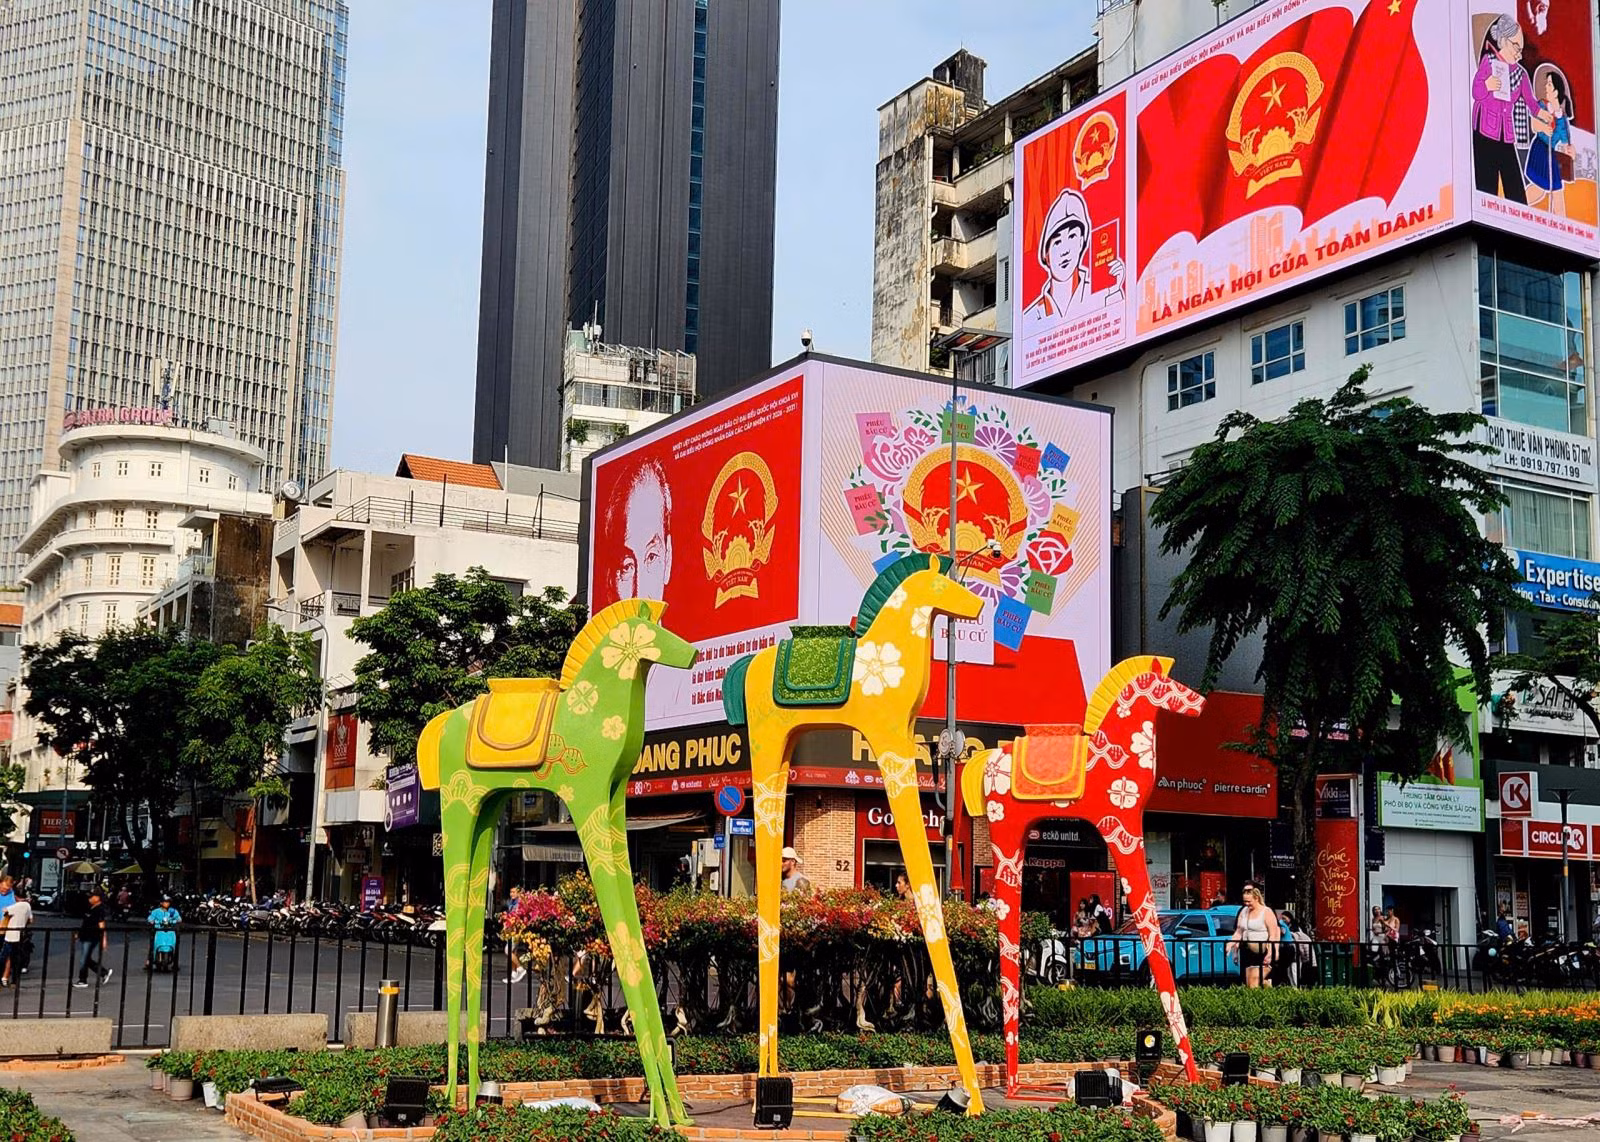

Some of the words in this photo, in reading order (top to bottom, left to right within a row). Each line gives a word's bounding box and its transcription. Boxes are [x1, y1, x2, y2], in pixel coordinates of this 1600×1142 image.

[1152, 303, 1172, 323] LÀ
[1178, 283, 1225, 314] NGÀY
[1231, 270, 1262, 291] HỘI
[1269, 253, 1308, 279] CỦA
[1315, 227, 1370, 261] TOÀN
[1378, 204, 1434, 239] DÂN!
[1488, 425, 1504, 447] CHO
[1506, 428, 1526, 453] THUÊ
[1504, 452, 1518, 466] LH:
[1520, 456, 1580, 478] 0919.797.199
[1526, 559, 1600, 593] Expertise
[1540, 590, 1556, 604] Tax
[632, 741, 680, 774] ANG
[685, 733, 742, 768] PHUC
[1214, 782, 1240, 793] pierre
[1241, 785, 1268, 795] cardin
[1316, 782, 1338, 799] Vikki
[1531, 830, 1571, 847] CIRCL
[836, 860, 850, 872] 52
[1028, 857, 1066, 868] Kappa
[1323, 916, 1345, 928] 2026
